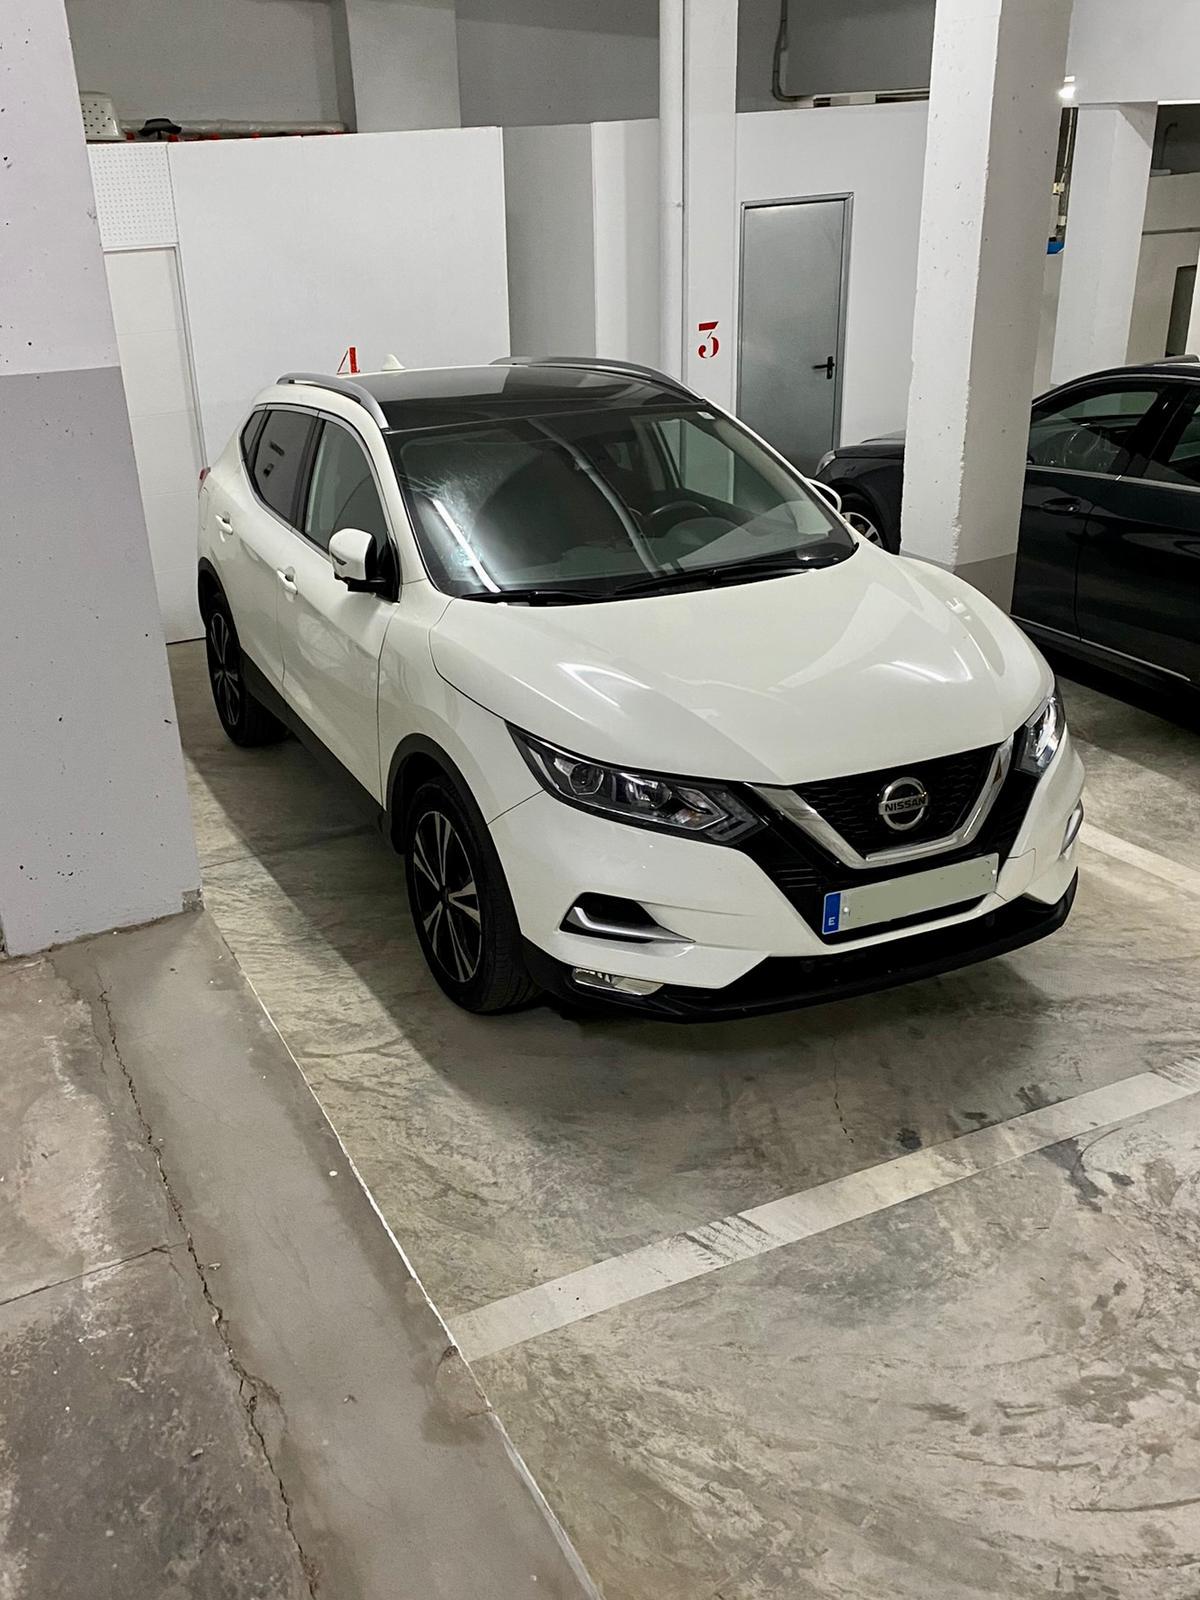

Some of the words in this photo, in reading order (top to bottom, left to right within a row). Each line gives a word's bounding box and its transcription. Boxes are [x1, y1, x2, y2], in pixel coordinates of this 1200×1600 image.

[698, 320, 720, 359] 3
[884, 797, 926, 812] NISSAN
[828, 916, 836, 926] E
